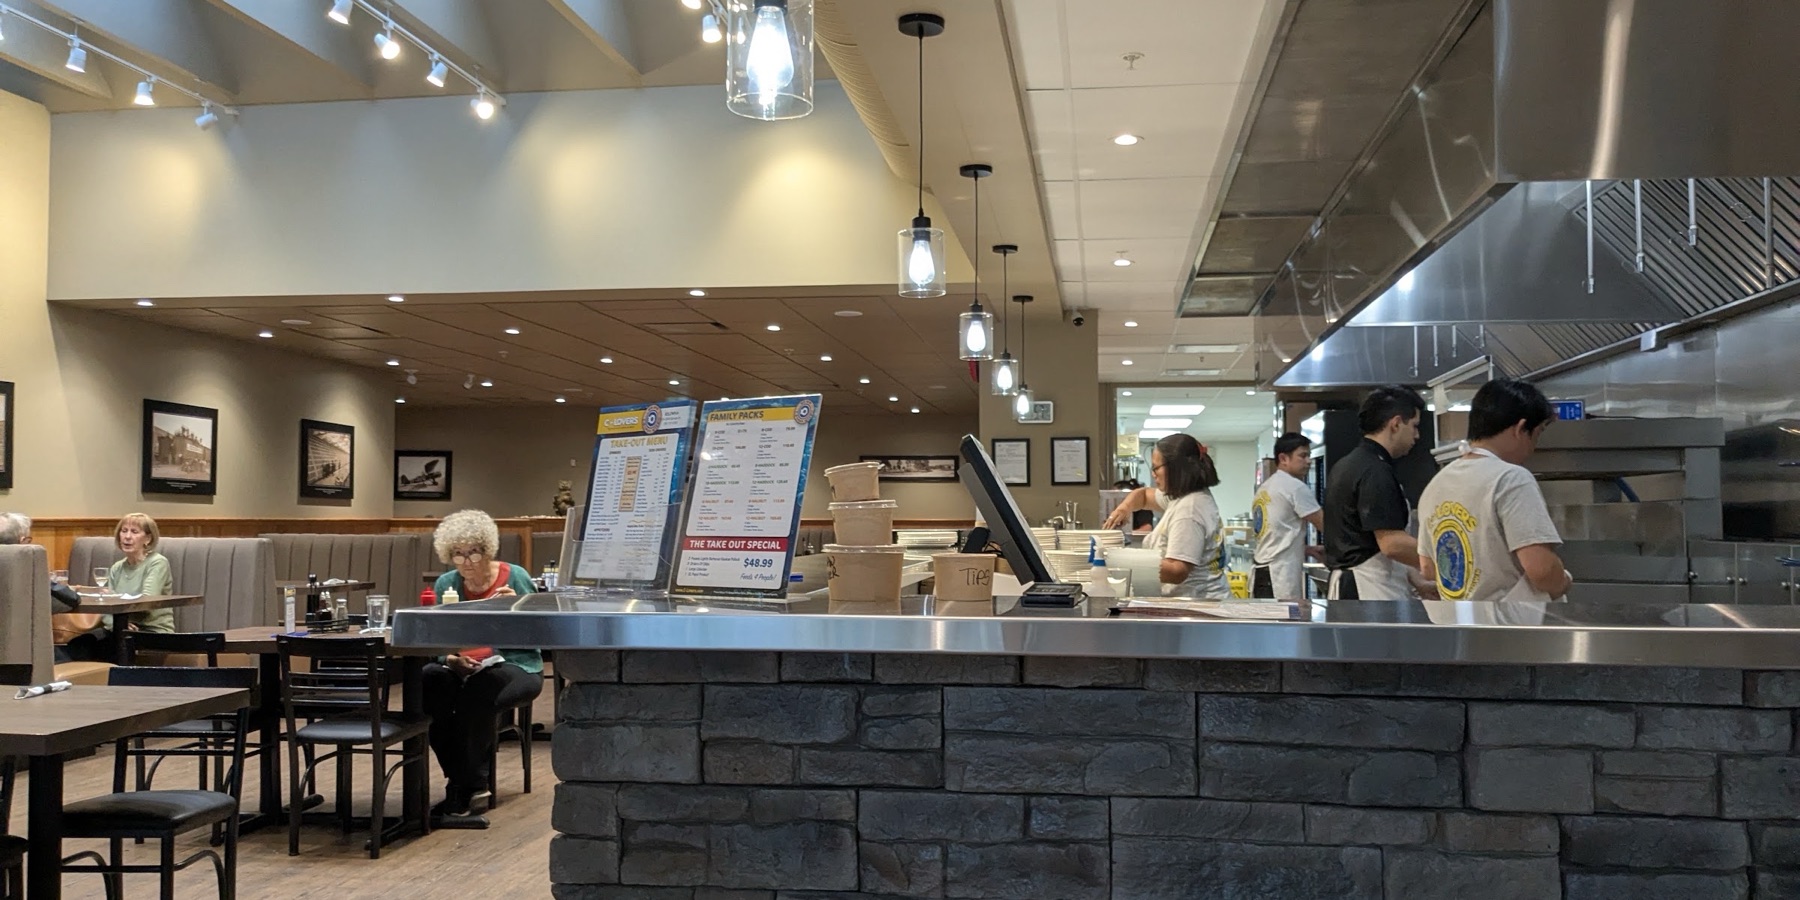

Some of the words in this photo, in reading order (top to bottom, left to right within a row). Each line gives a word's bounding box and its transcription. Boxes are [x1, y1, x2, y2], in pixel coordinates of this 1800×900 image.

[710, 412, 738, 420] FAMILY
[739, 411, 764, 419] PACKS
[689, 539, 704, 549] THE
[706, 539, 727, 549] TAKE
[728, 540, 746, 549] OUT
[746, 540, 781, 550] SPECIAL
[743, 557, 773, 568] $48.99
